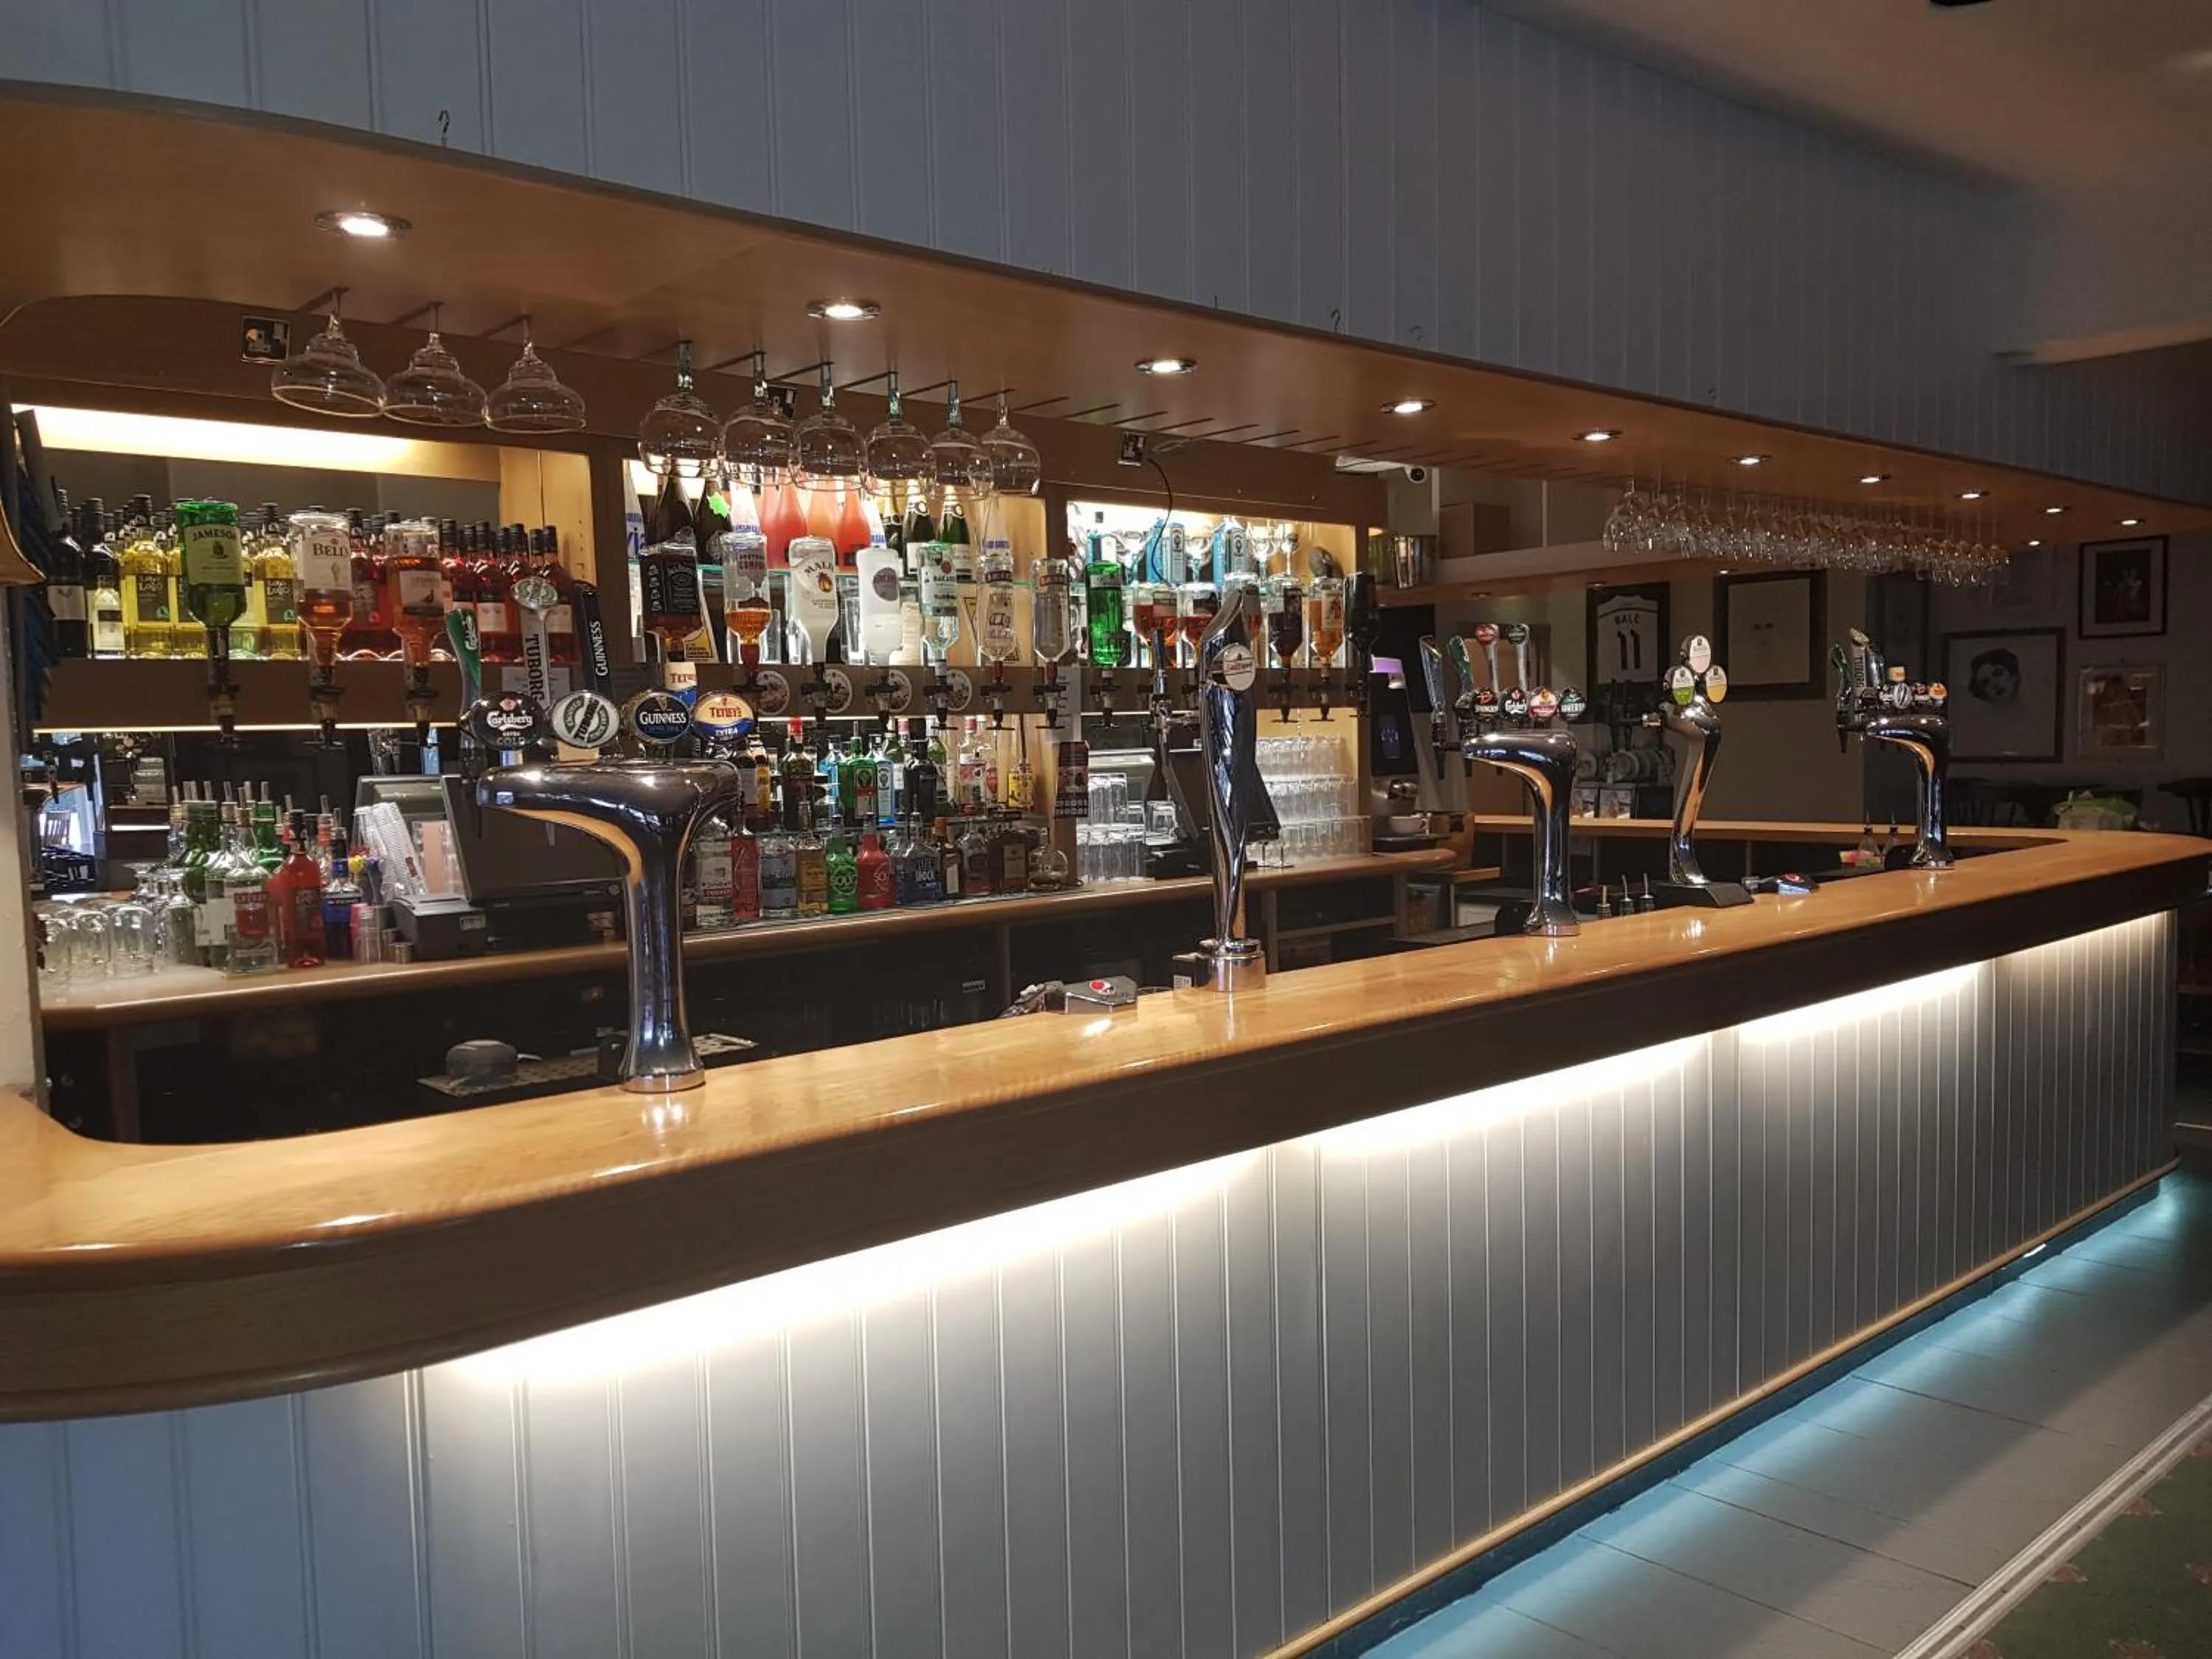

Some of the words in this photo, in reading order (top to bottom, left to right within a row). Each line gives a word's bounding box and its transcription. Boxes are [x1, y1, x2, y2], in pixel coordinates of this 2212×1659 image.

[192, 529, 236, 541] JAMESON
[1614, 613, 1641, 625] BALE
[590, 620, 608, 676] GUINNESS
[1617, 629, 1641, 671] 11
[525, 633, 545, 700] TUBORG
[486, 710, 534, 730] Carlsberg
[574, 697, 599, 741] TUBORG
[639, 712, 686, 725] GUINNESS
